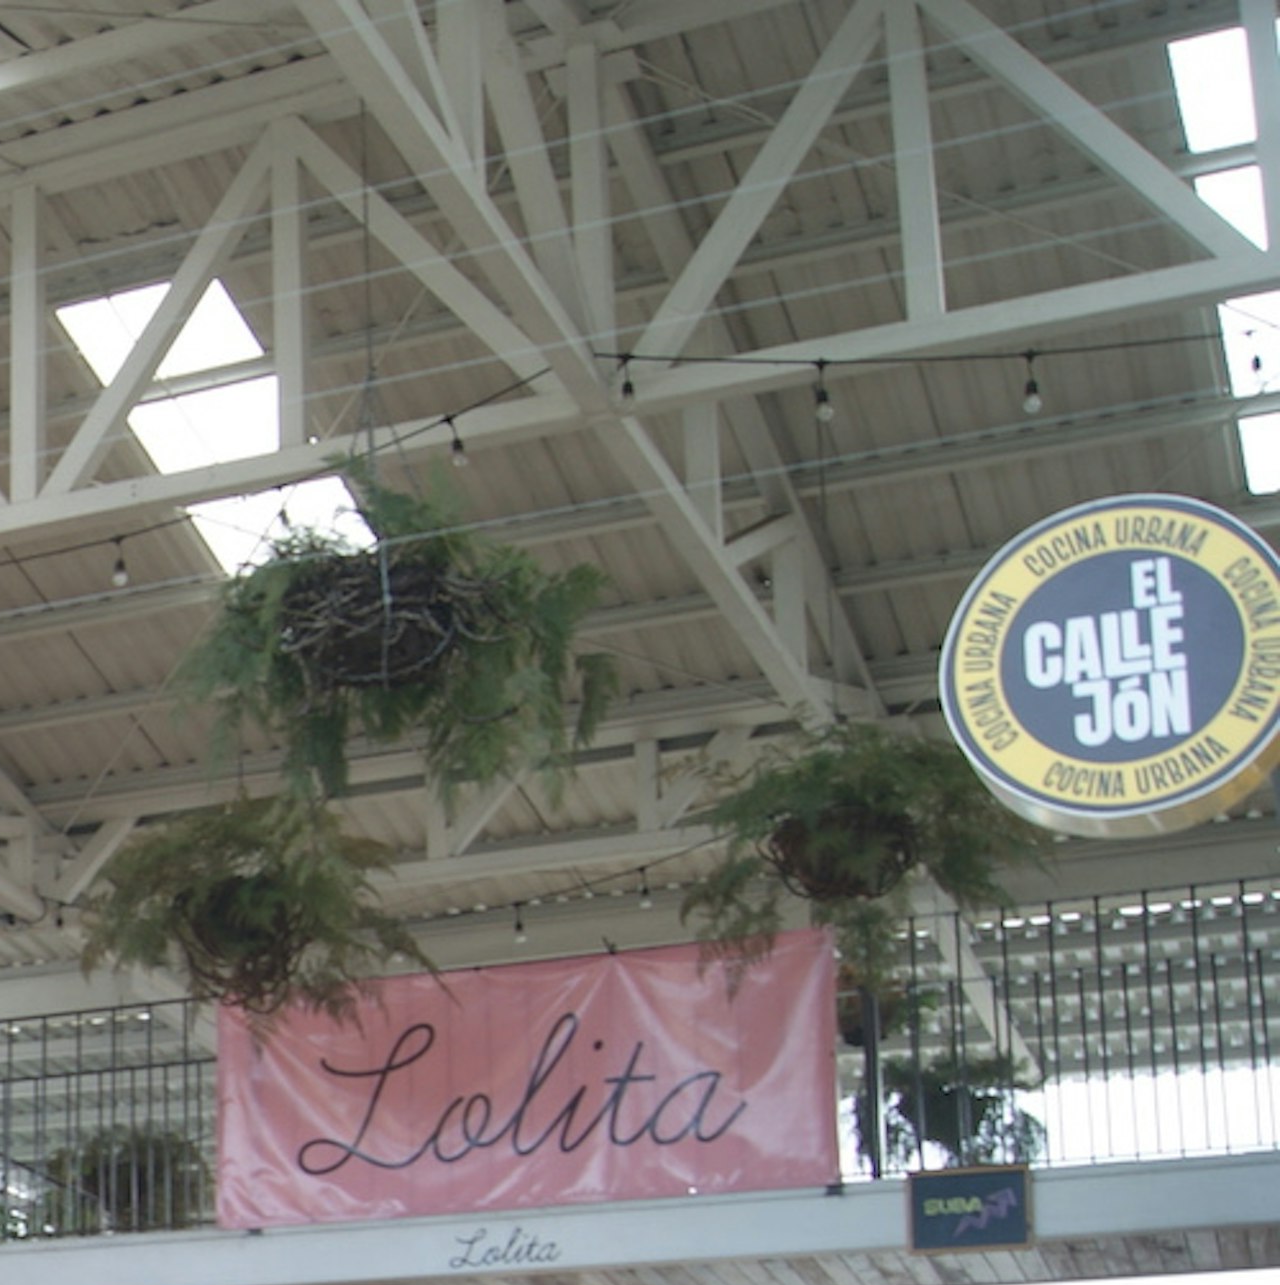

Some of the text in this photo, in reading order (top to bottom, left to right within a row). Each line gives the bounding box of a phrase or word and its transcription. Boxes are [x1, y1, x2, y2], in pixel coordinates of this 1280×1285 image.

[1024, 515, 1209, 577] COCINA URBANA
[1130, 557, 1183, 608] EL
[1223, 556, 1280, 632] COCINA
[963, 590, 1019, 752] COCINA URBANA
[1023, 605, 1187, 689] CALLE
[1043, 735, 1230, 798] COCINA URBANA
[297, 1012, 746, 1176] Lolita
[448, 1226, 562, 1269] Lolita
